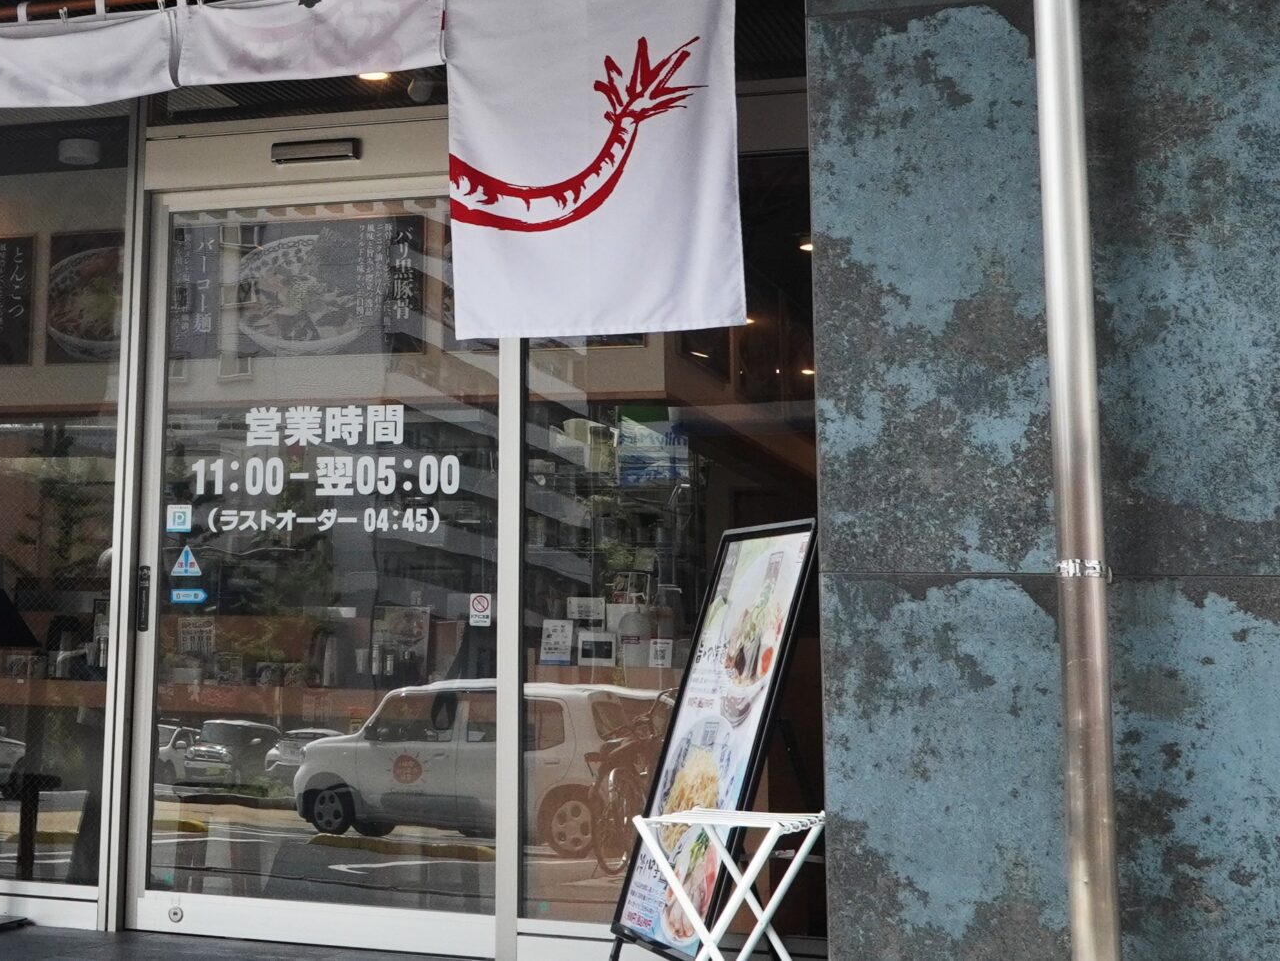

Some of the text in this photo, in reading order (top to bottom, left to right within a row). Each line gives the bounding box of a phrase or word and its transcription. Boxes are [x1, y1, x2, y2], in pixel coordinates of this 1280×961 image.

[8, 246, 26, 318] とんこつ
[393, 226, 414, 320] バリ黒豚骨
[245, 404, 405, 447] 営業時間
